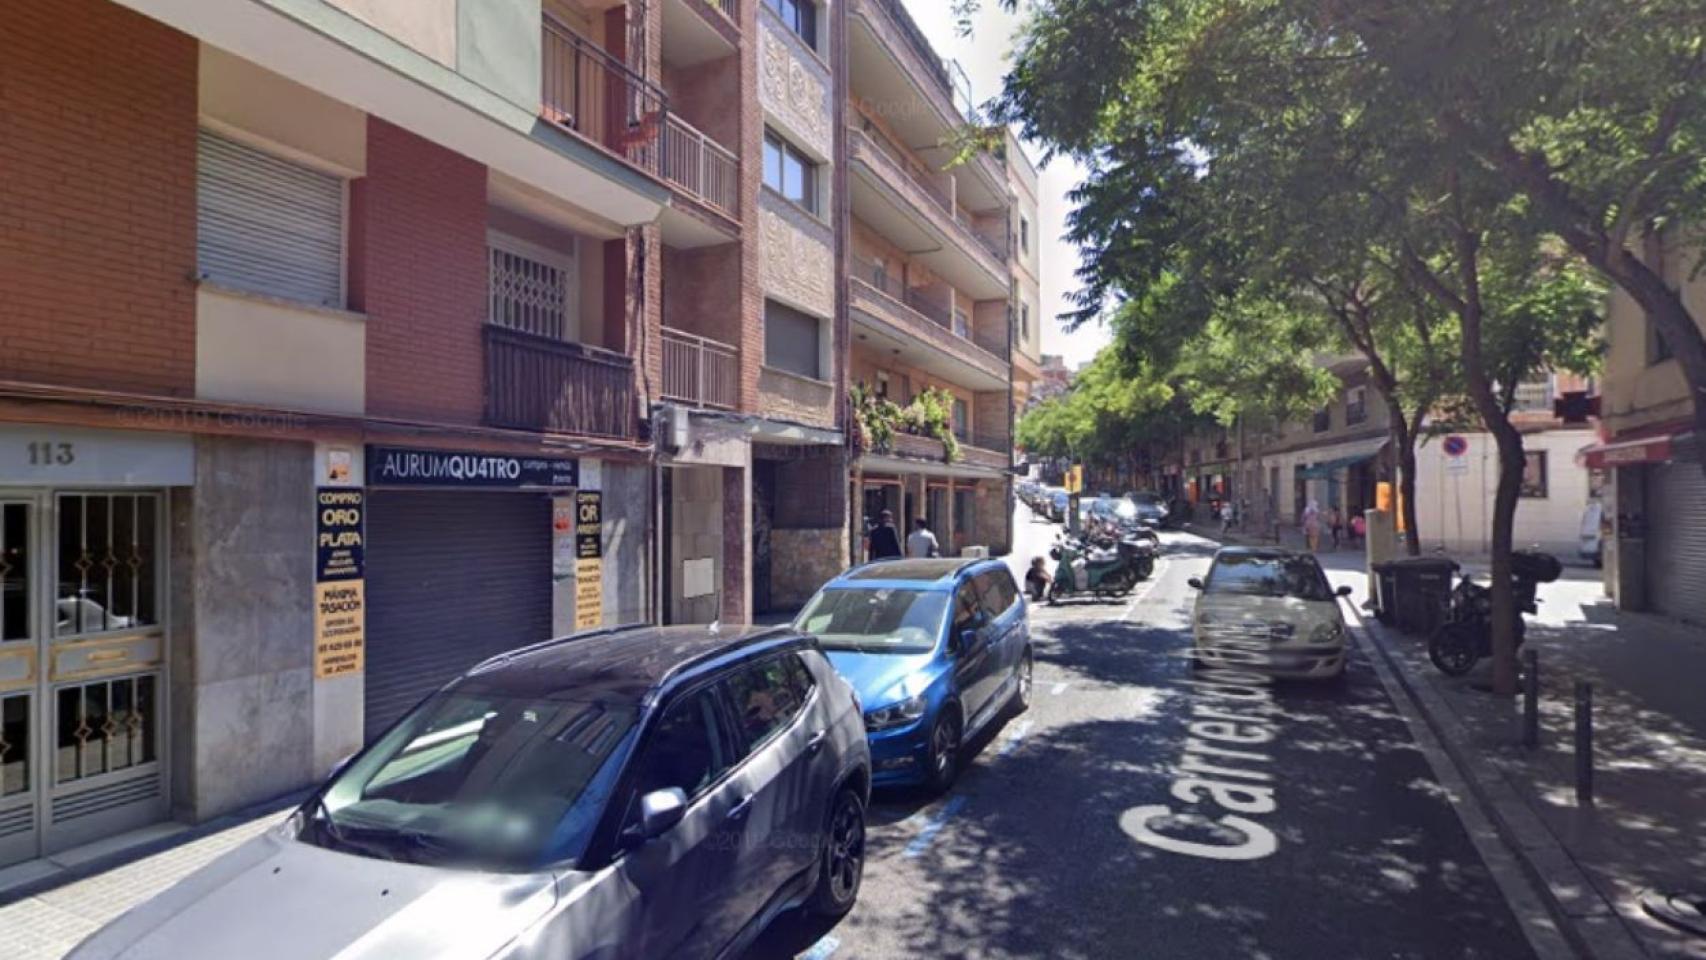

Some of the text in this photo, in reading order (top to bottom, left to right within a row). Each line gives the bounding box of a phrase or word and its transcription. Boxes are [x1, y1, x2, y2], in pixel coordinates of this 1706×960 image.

[27, 441, 75, 465] 113
[383, 453, 520, 479] AURUMQU4TRO
[319, 492, 362, 505] COMPRO
[322, 508, 360, 526] ORO
[579, 504, 599, 522] OR
[319, 532, 362, 547] PLATA
